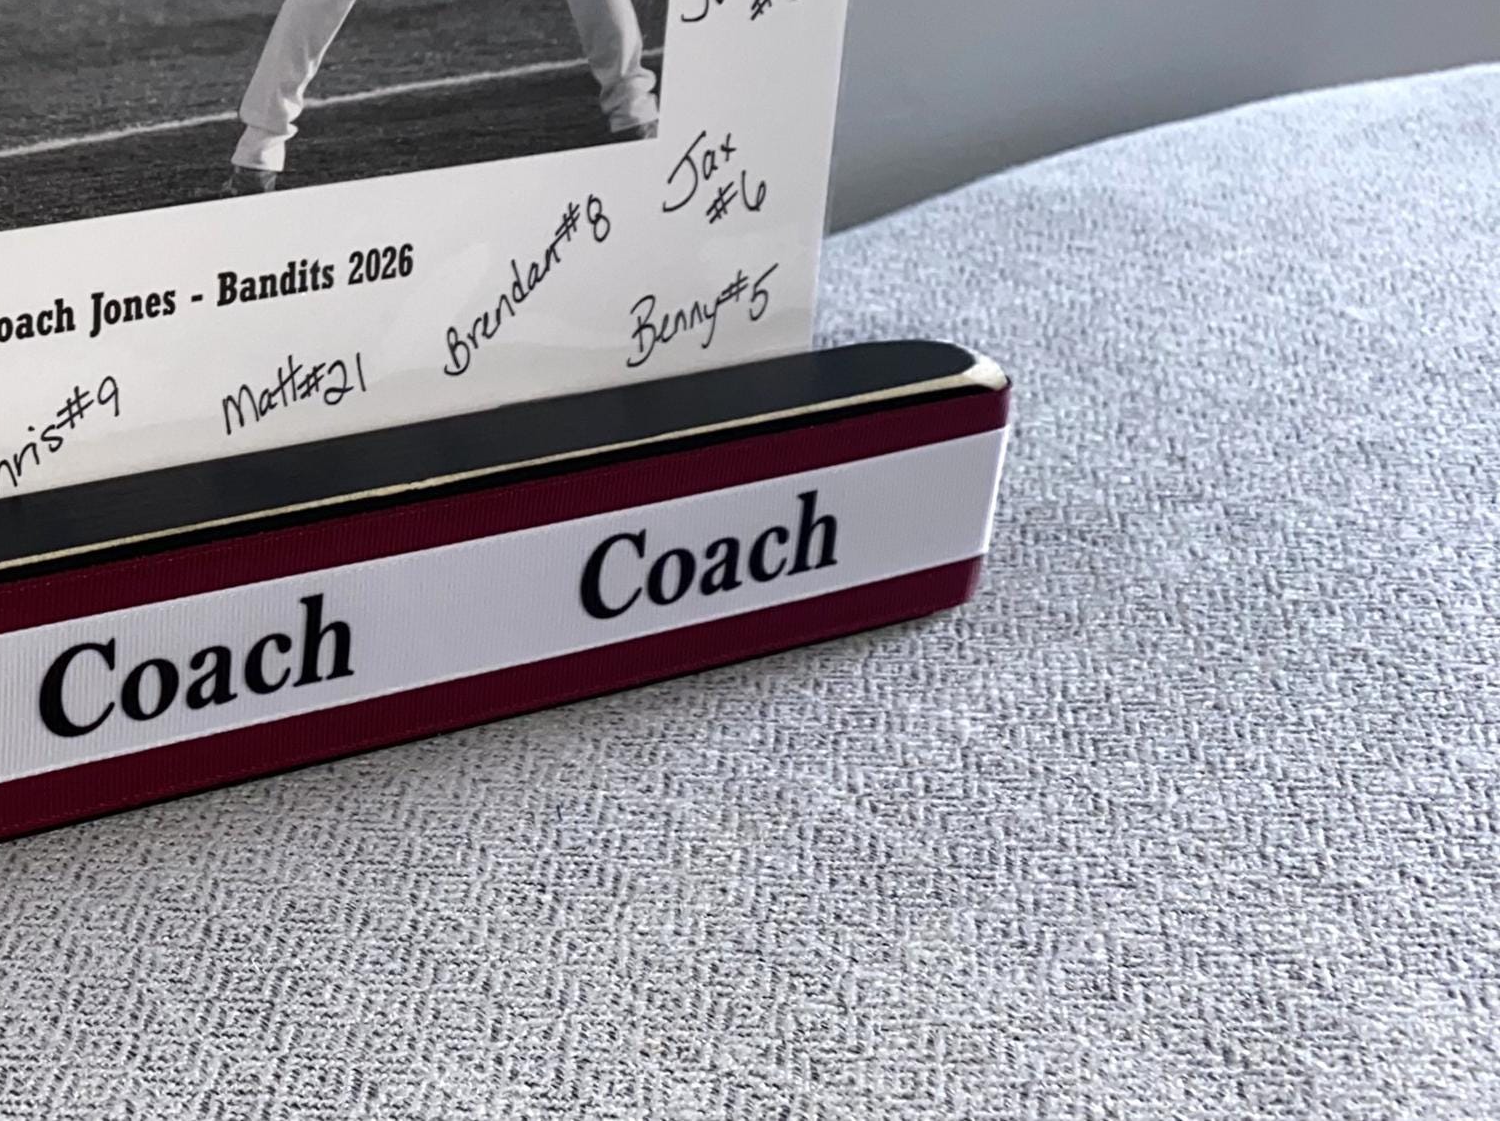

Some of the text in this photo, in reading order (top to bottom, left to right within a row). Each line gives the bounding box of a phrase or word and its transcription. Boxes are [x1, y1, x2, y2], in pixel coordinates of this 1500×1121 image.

[660, 129, 738, 213] Jax
[704, 168, 768, 226] #6
[87, 288, 178, 340] Jones
[215, 257, 336, 309] Bandits
[346, 241, 415, 287] 2026
[579, 489, 839, 621] Coach
[38, 592, 355, 739] Coach
